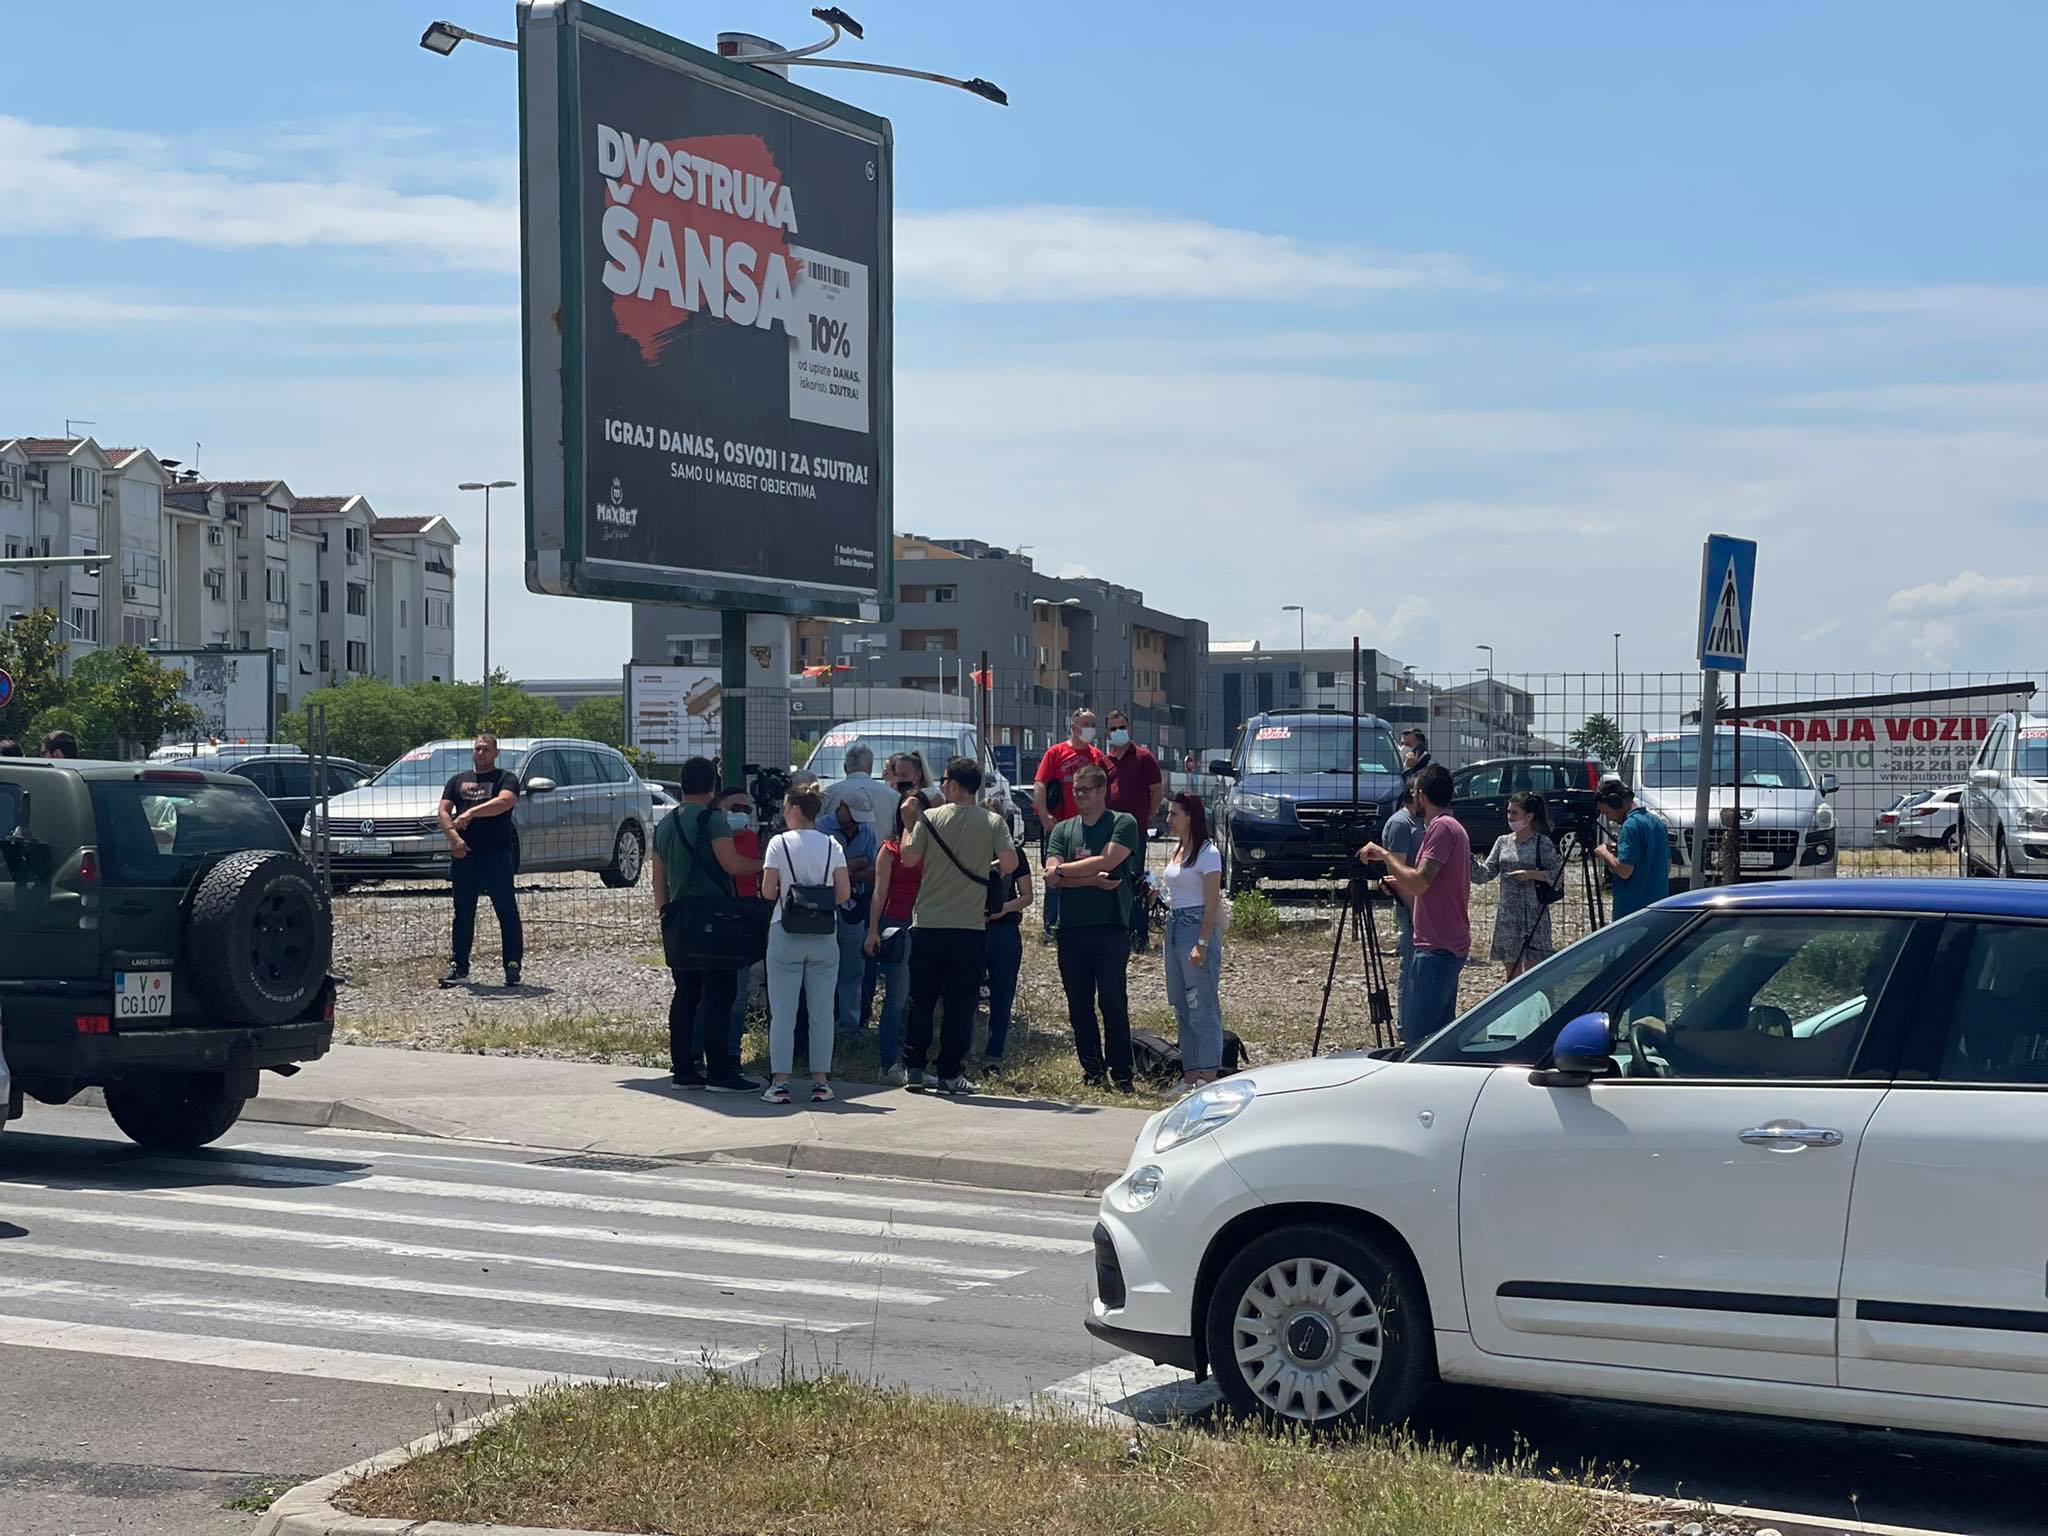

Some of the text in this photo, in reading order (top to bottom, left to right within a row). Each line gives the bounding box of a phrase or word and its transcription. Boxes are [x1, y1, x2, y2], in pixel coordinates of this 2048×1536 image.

[598, 123, 799, 234] DVOSTRUKA
[602, 178, 803, 339] ŠANSA
[808, 313, 851, 359] 10%
[797, 360, 808, 371] od
[828, 383, 859, 400] SJUTRA!
[604, 418, 869, 486] IGRAJ DANAS, OSVOJI I ZA SJUTRA!
[670, 461, 817, 500] SAMO U MAXBET OBJEKTIMA
[140, 976, 148, 993] V
[121, 994, 166, 1015] CG107
